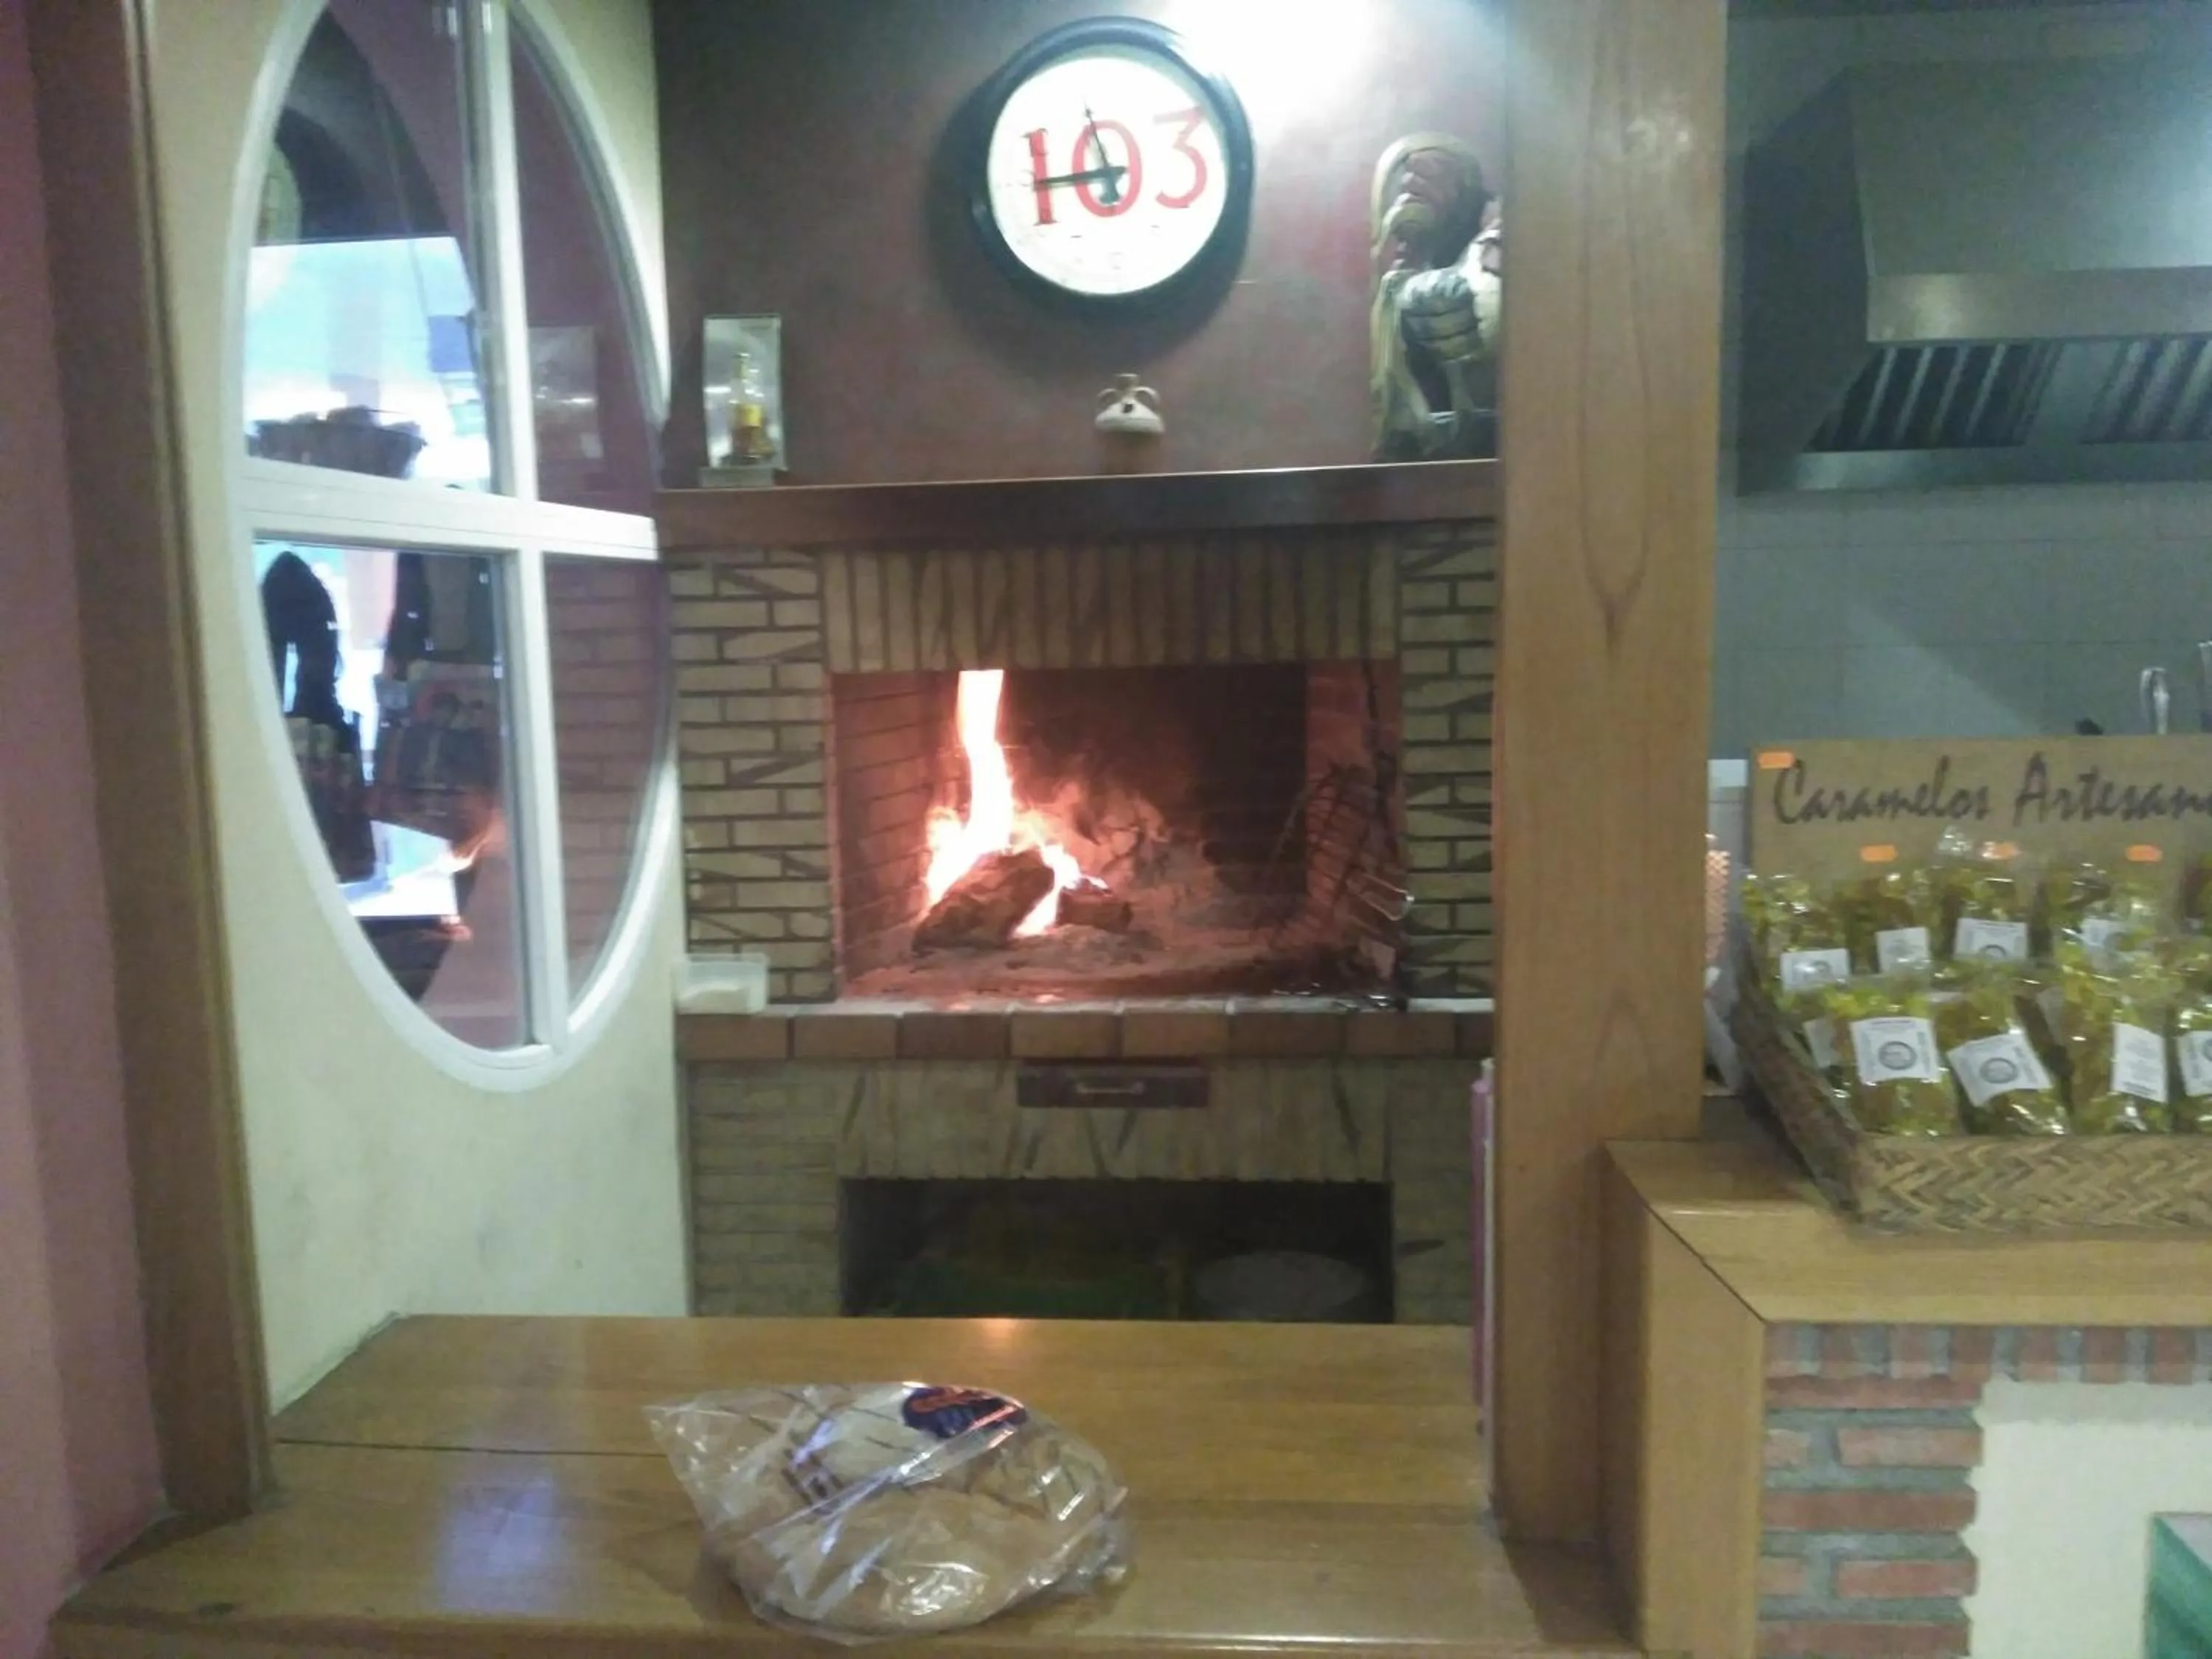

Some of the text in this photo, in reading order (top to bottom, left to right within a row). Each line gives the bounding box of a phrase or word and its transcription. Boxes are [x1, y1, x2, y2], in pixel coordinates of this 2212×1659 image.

[1023, 105, 1208, 226] 103
[1773, 751, 2212, 827] Caramelos Artesan
